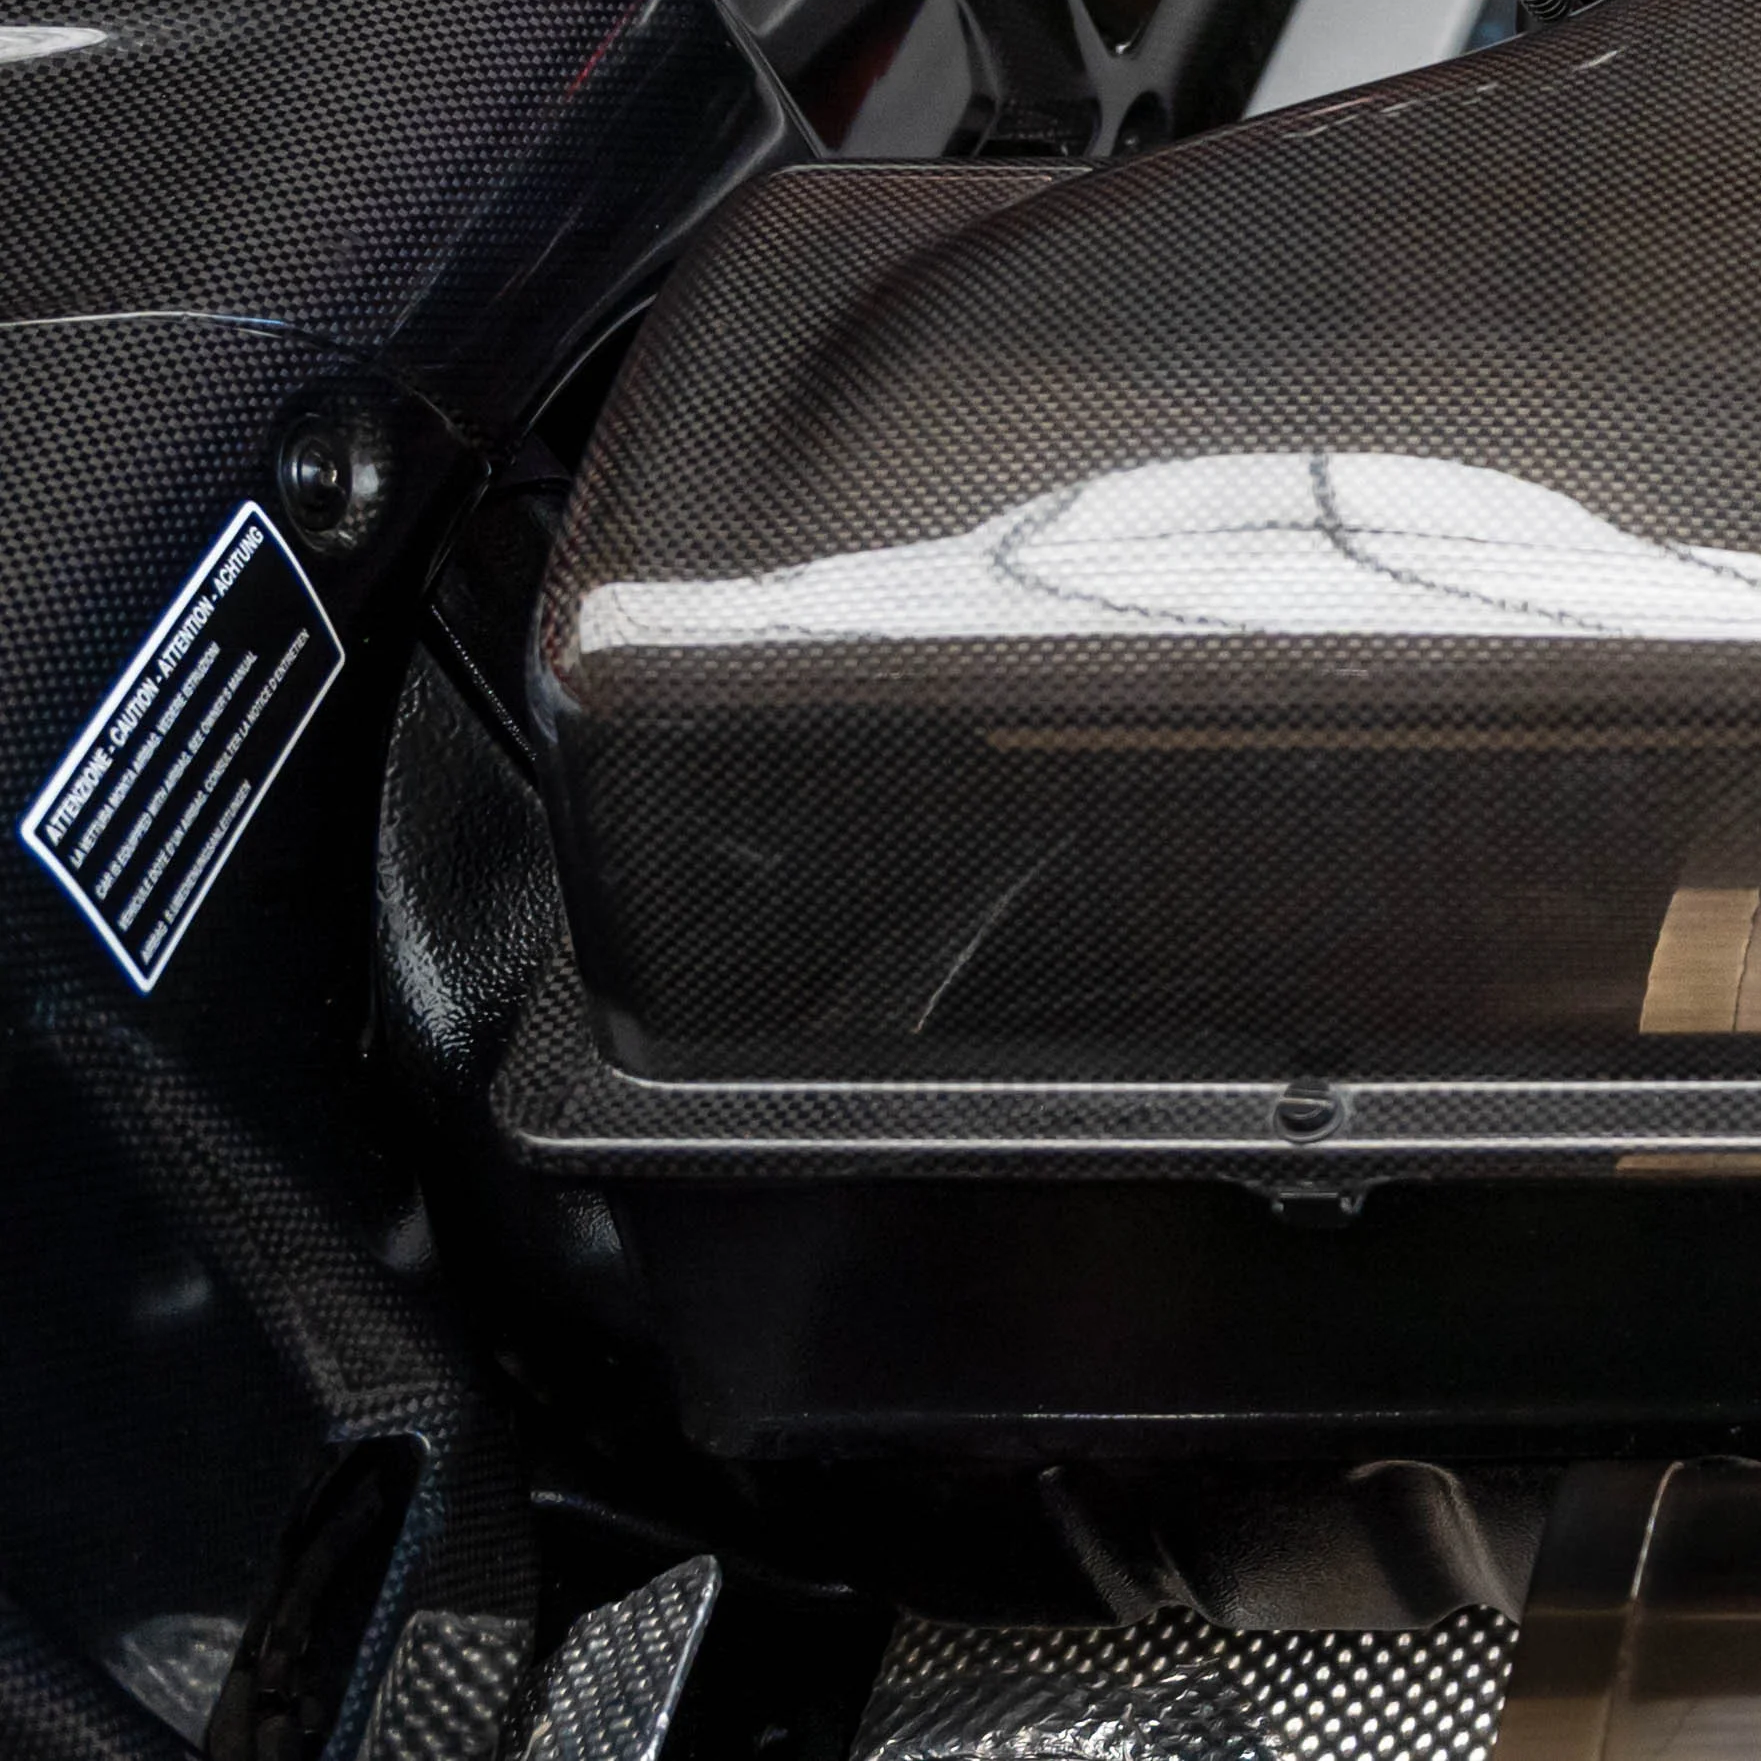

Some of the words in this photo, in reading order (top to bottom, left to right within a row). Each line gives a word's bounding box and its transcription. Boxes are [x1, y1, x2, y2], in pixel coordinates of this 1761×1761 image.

[45, 746, 112, 845] ATTENZIONE
[111, 676, 158, 749] CAUTION
[158, 594, 213, 678] ATTENTION
[214, 522, 262, 598] ACHTUNG
[69, 845, 85, 869] LA
[156, 690, 186, 736] VEDERE
[93, 869, 115, 902] CAR
[147, 784, 169, 818] WITH
[187, 727, 204, 755] SEE
[228, 646, 257, 693] MANUAL
[206, 731, 241, 790] CONSULTER
[238, 718, 250, 738] LA
[247, 684, 272, 726] NOTICE
